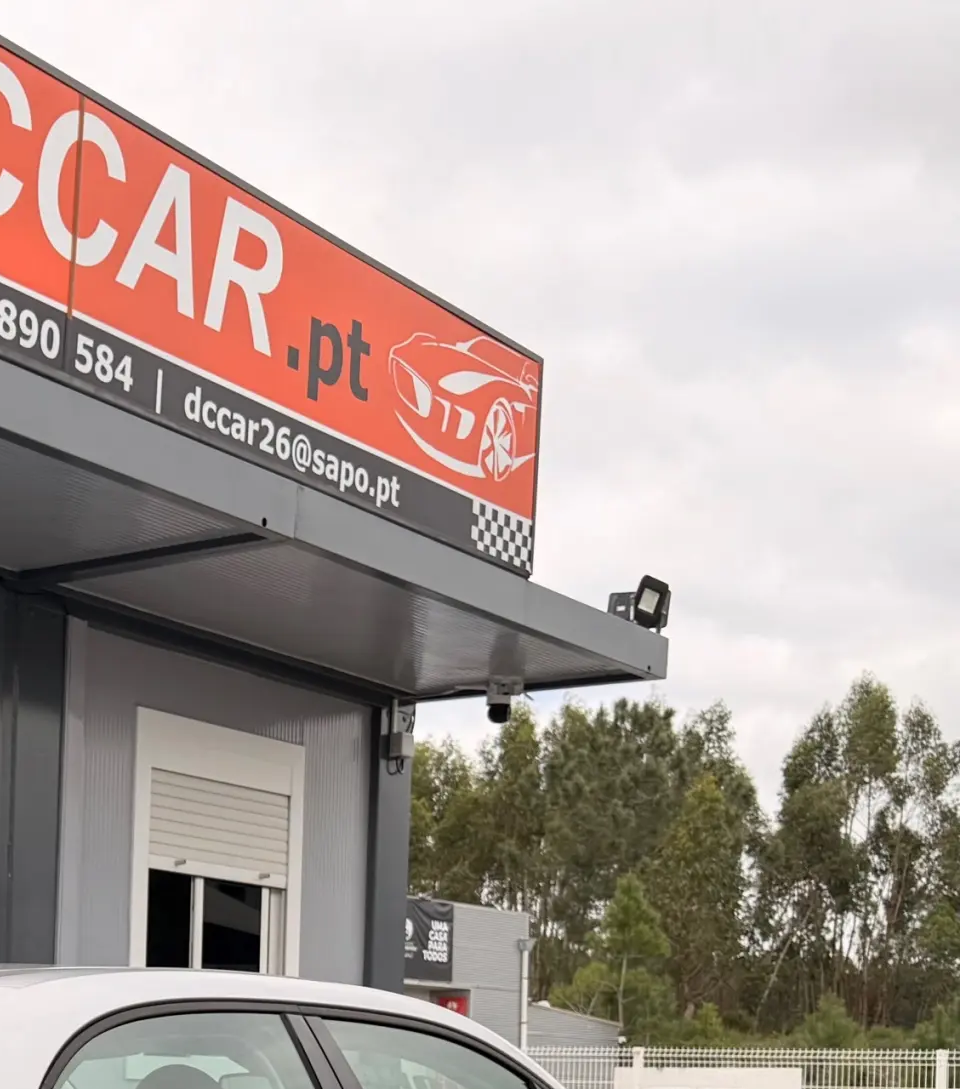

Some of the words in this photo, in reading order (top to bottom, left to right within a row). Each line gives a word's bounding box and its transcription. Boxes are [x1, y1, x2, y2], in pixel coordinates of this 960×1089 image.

[73, 333, 134, 392] 584
[184, 386, 401, 508] dccar26@sapo.pt
[431, 920, 448, 932] UMA
[428, 930, 448, 942] CASA
[428, 940, 448, 952] PARA
[422, 949, 448, 963] TODOS
